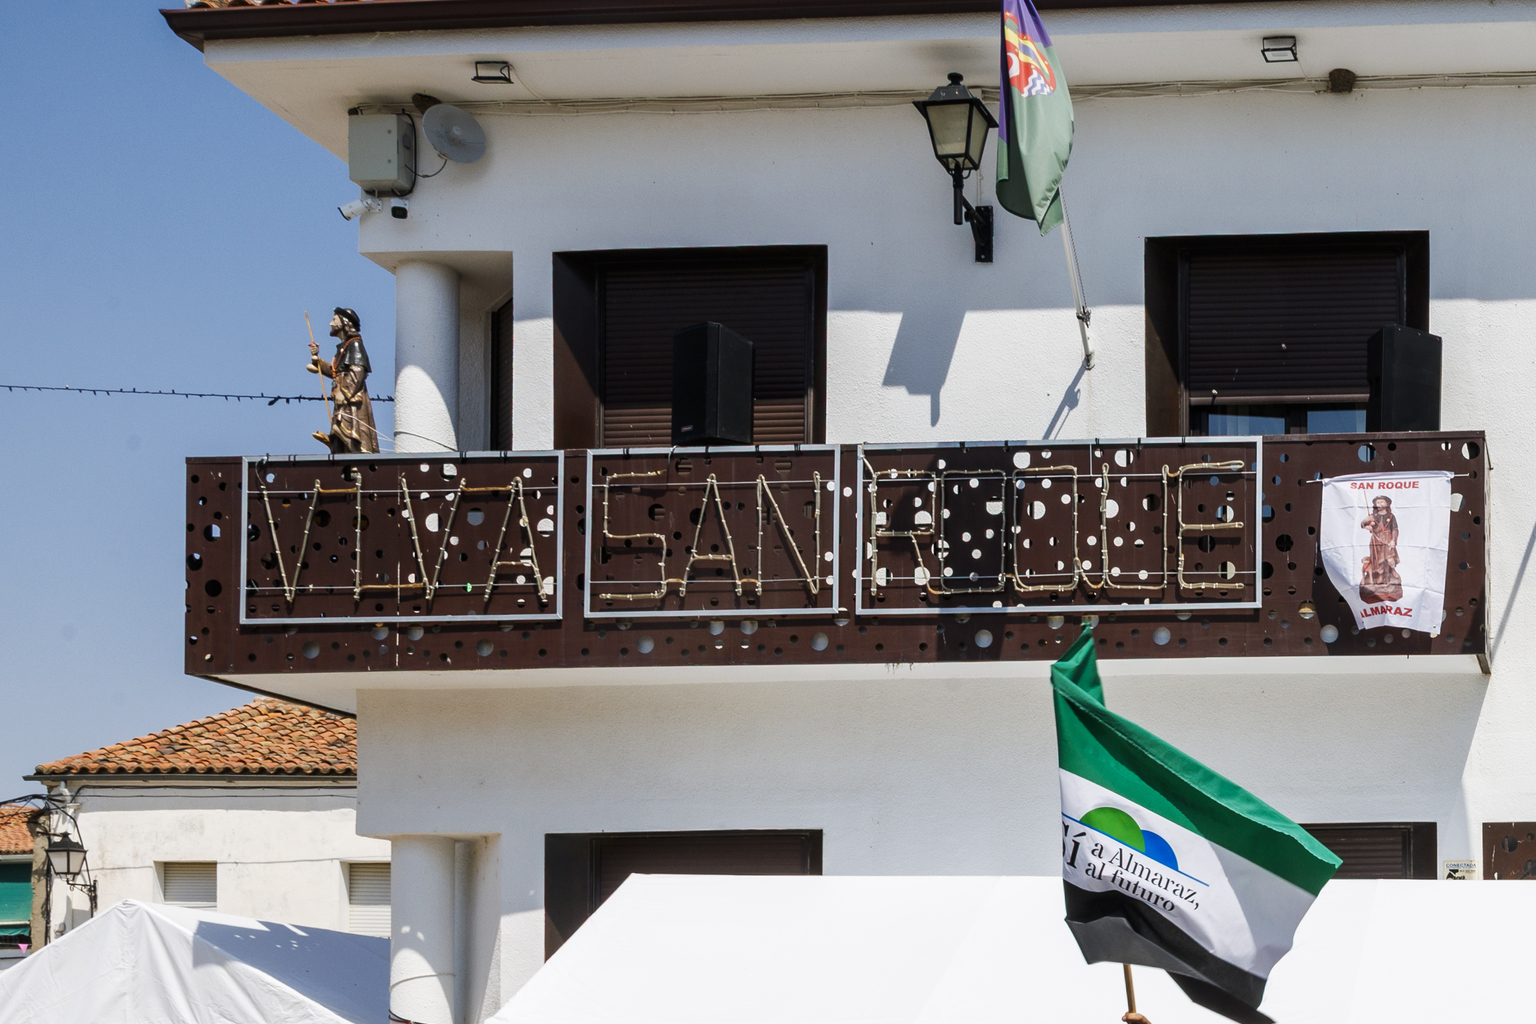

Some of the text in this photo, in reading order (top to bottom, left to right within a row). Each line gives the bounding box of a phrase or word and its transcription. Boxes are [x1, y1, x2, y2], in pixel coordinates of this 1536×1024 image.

[1350, 480, 1420, 490] SAN ROQUE
[260, 460, 1245, 602] VIVA SAN ROQUE
[1085, 861, 1176, 912] al futuro
[1091, 842, 1104, 859] a
[1108, 847, 1200, 911] Almaraz,
